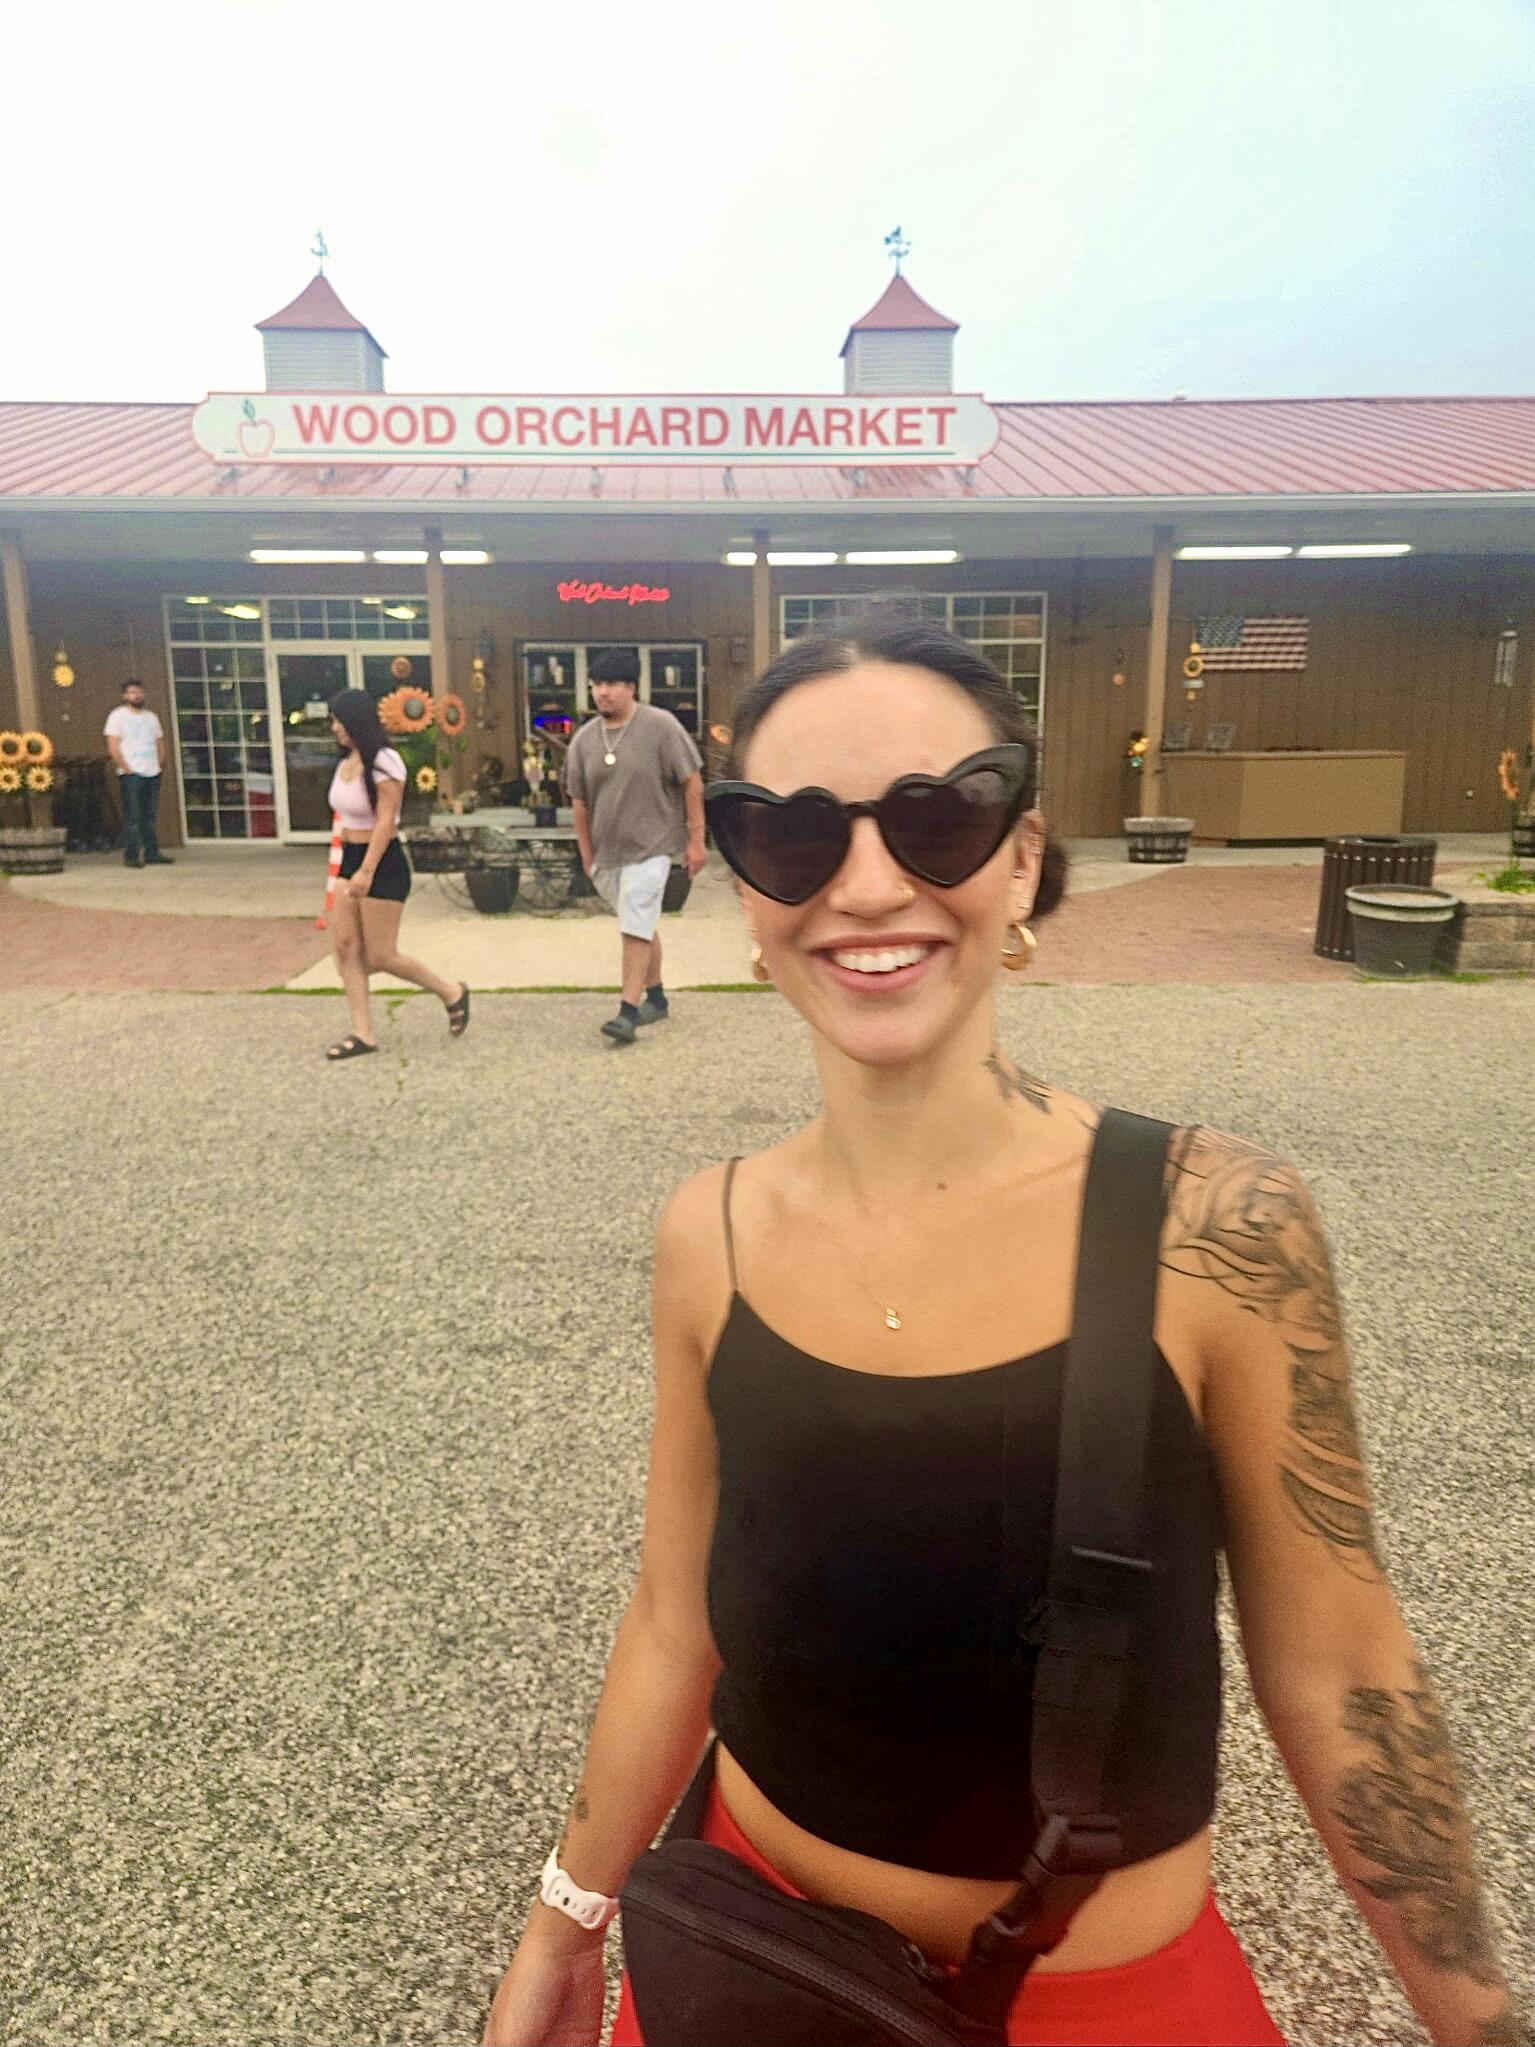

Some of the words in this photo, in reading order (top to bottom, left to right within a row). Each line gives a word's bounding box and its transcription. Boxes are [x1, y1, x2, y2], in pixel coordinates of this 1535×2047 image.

[292, 404, 456, 444] WOOD
[475, 405, 729, 446] ORCHARD
[744, 406, 957, 446] MARKET
